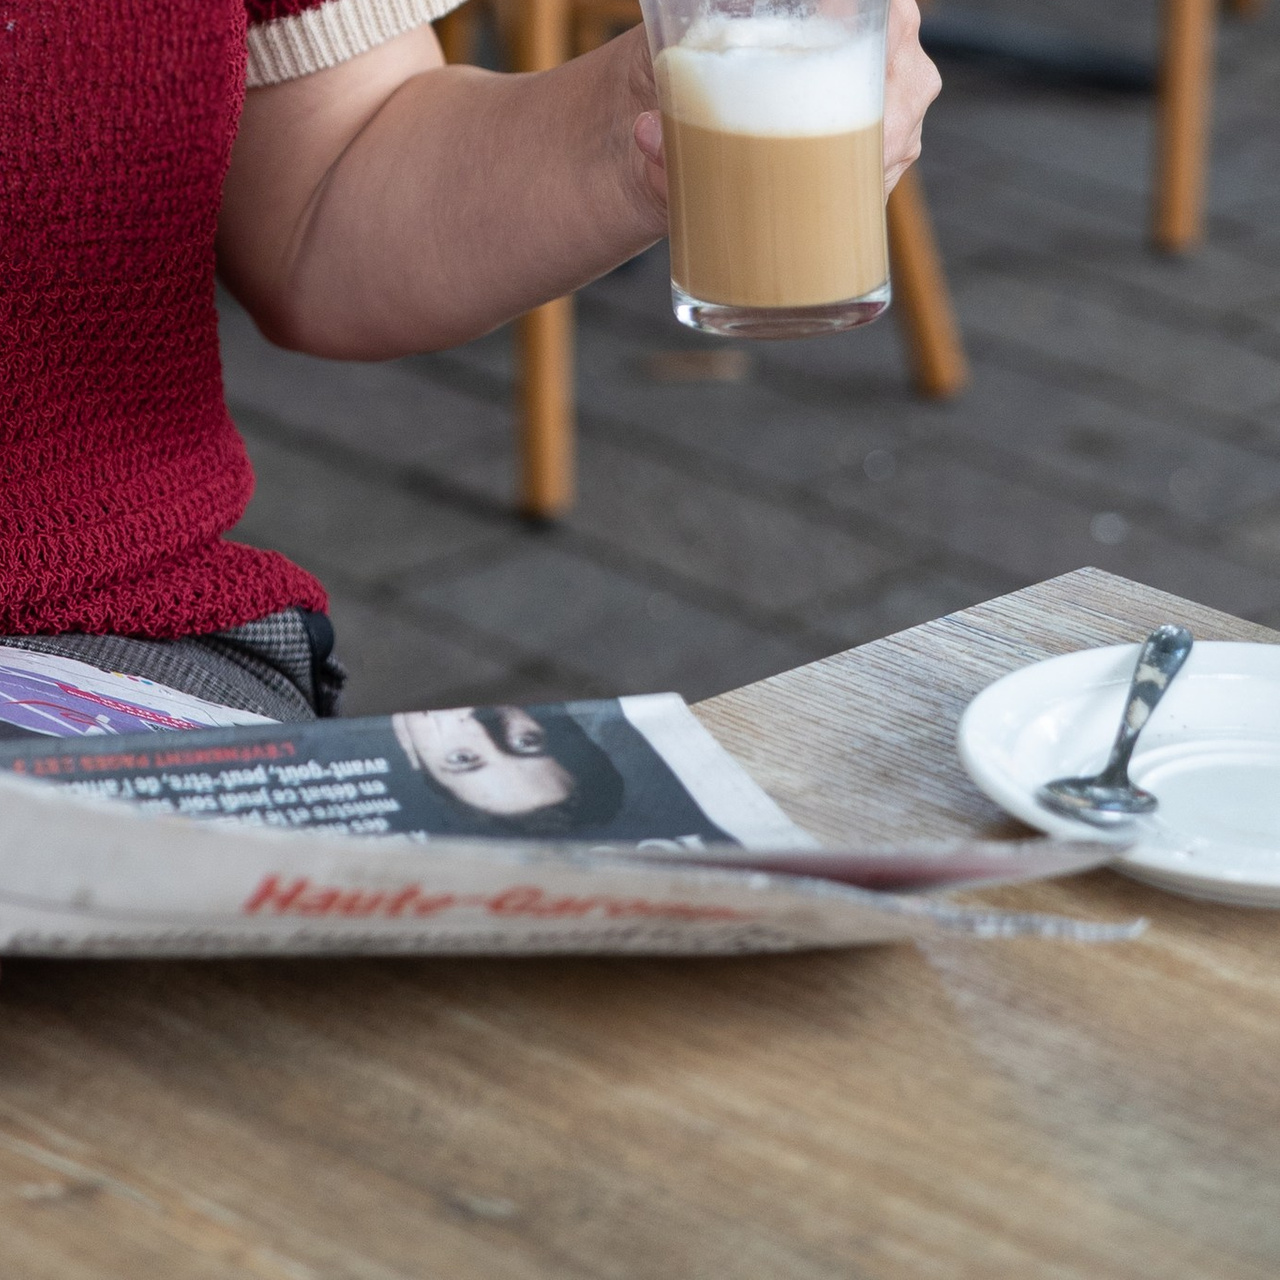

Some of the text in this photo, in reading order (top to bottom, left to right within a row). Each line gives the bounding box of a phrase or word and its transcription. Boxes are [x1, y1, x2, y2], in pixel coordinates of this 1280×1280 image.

[161, 763, 268, 792] peut-être,
[268, 757, 390, 785] avant-goût,
[134, 775, 160, 796] de
[272, 788, 297, 804] ce
[297, 782, 358, 804] débat
[359, 780, 386, 795] en
[219, 786, 272, 813] jeudi
[312, 797, 402, 820] ministre
[265, 808, 285, 825] le
[286, 806, 312, 827] et
